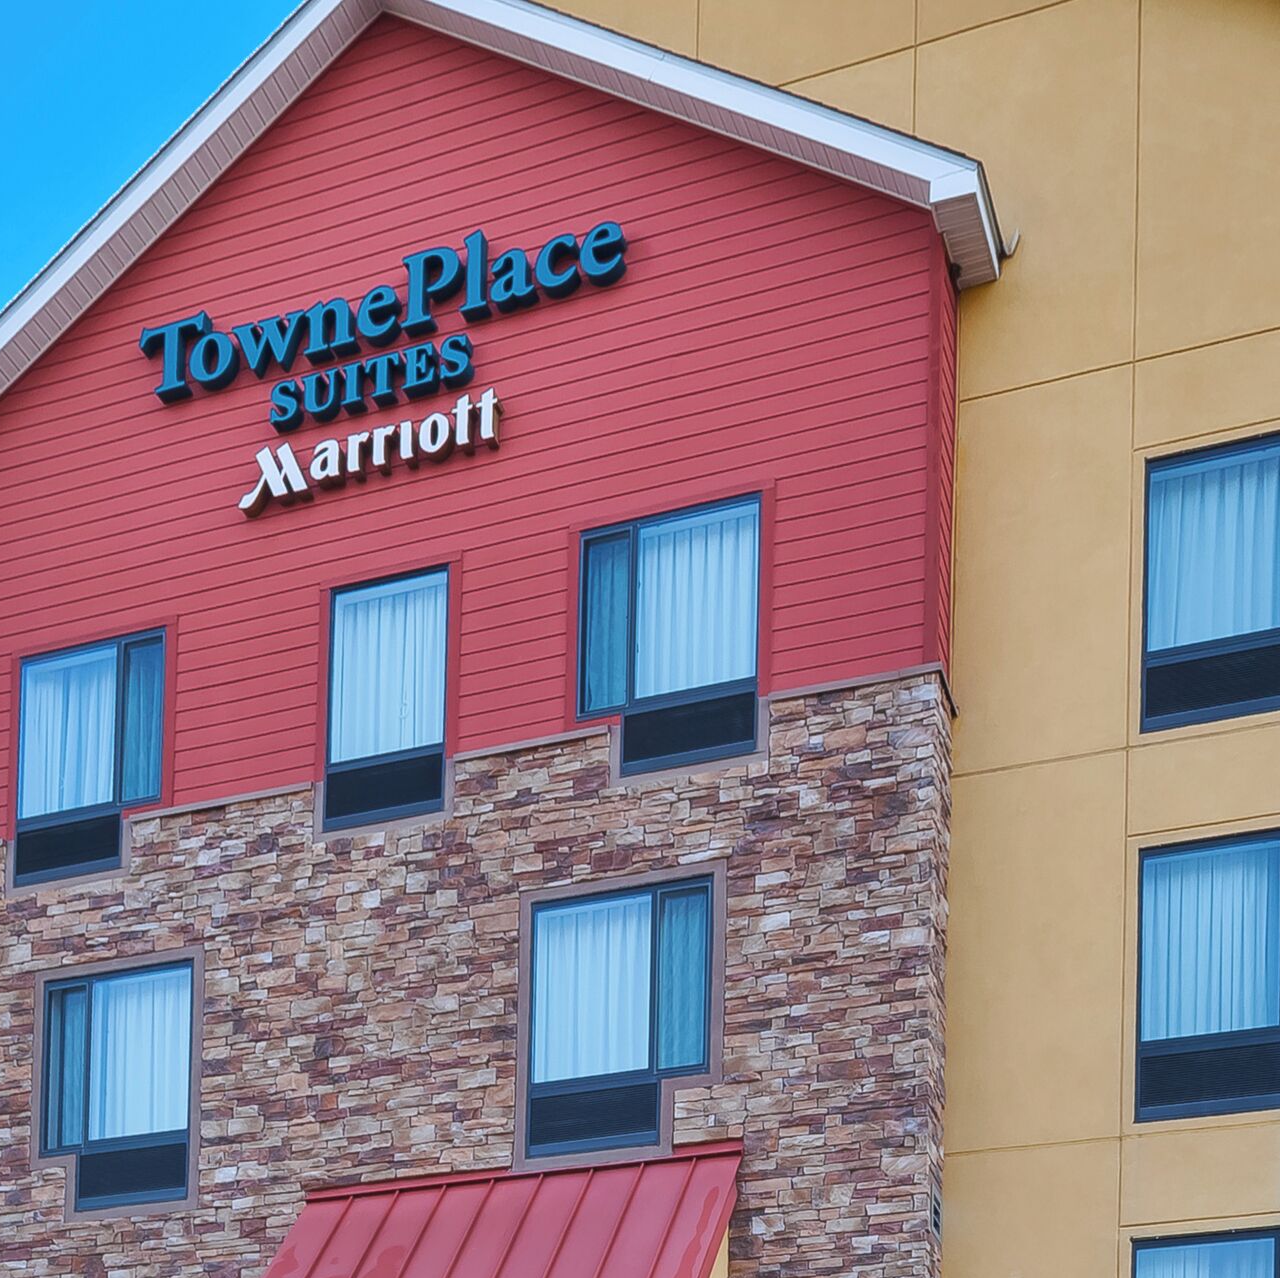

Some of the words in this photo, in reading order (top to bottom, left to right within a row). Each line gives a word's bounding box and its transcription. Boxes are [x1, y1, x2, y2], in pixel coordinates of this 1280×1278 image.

[139, 220, 628, 404] TownePlace
[268, 333, 475, 433] SUITES
[237, 387, 504, 519] Marriott
